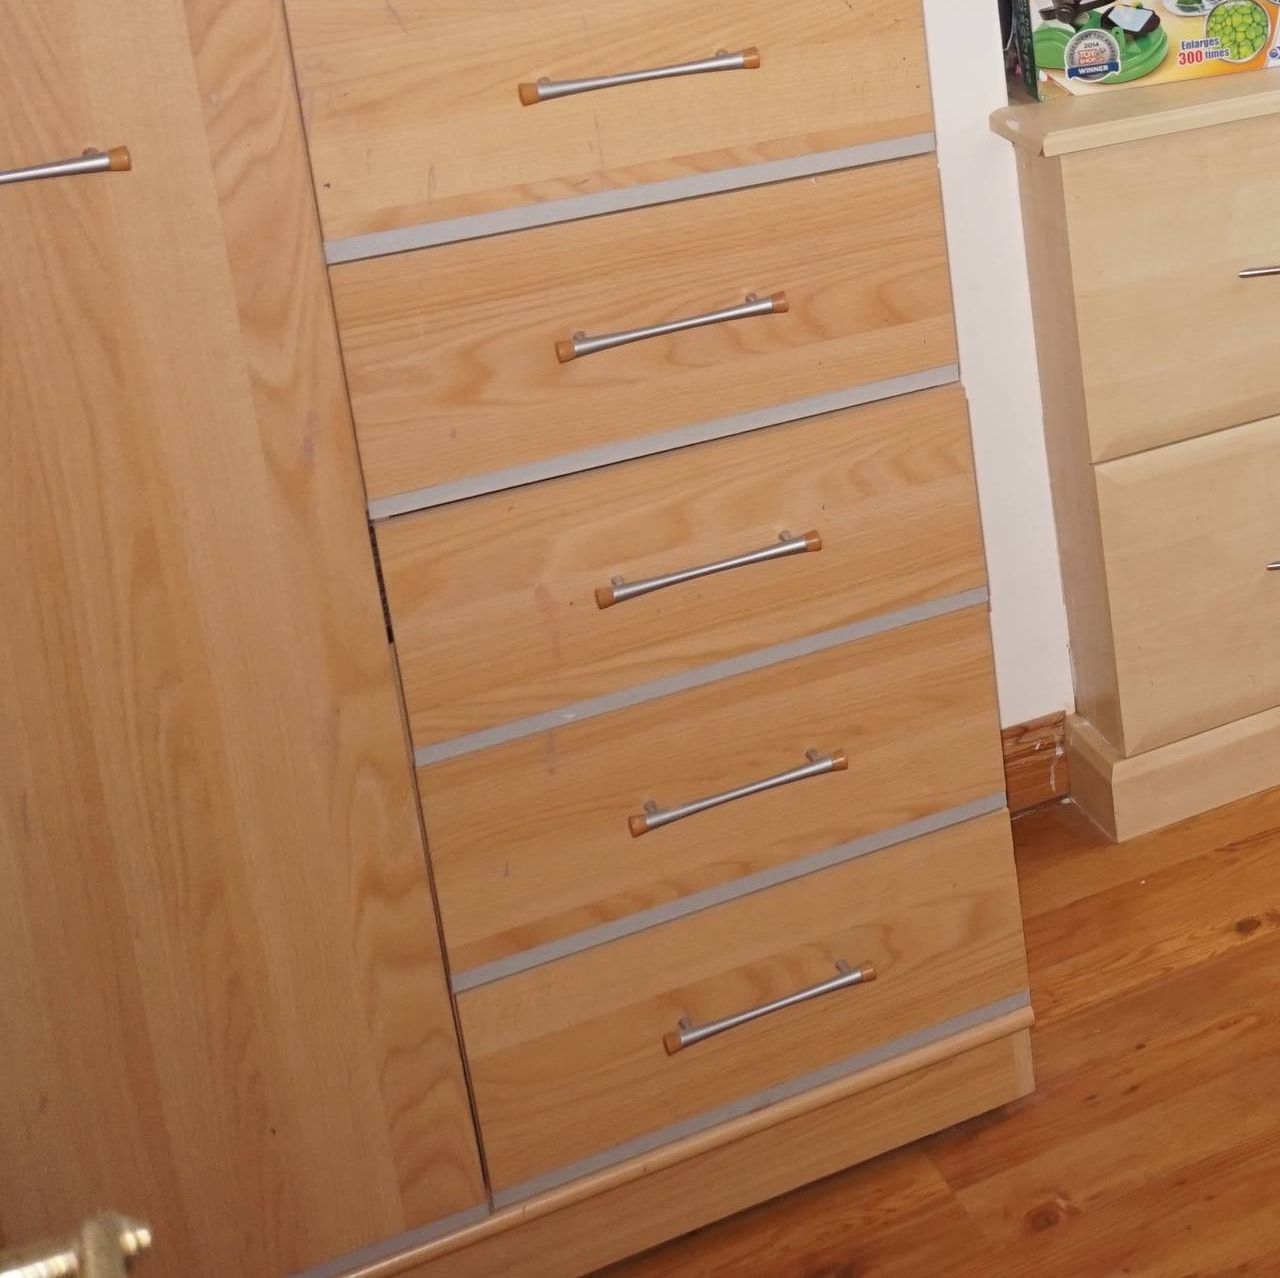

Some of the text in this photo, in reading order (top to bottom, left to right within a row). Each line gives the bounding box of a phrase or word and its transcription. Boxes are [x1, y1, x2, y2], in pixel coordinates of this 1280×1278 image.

[1181, 37, 1219, 50] Enlarges
[1178, 48, 1230, 65] 300 times
[1078, 64, 1109, 74] WINNER
